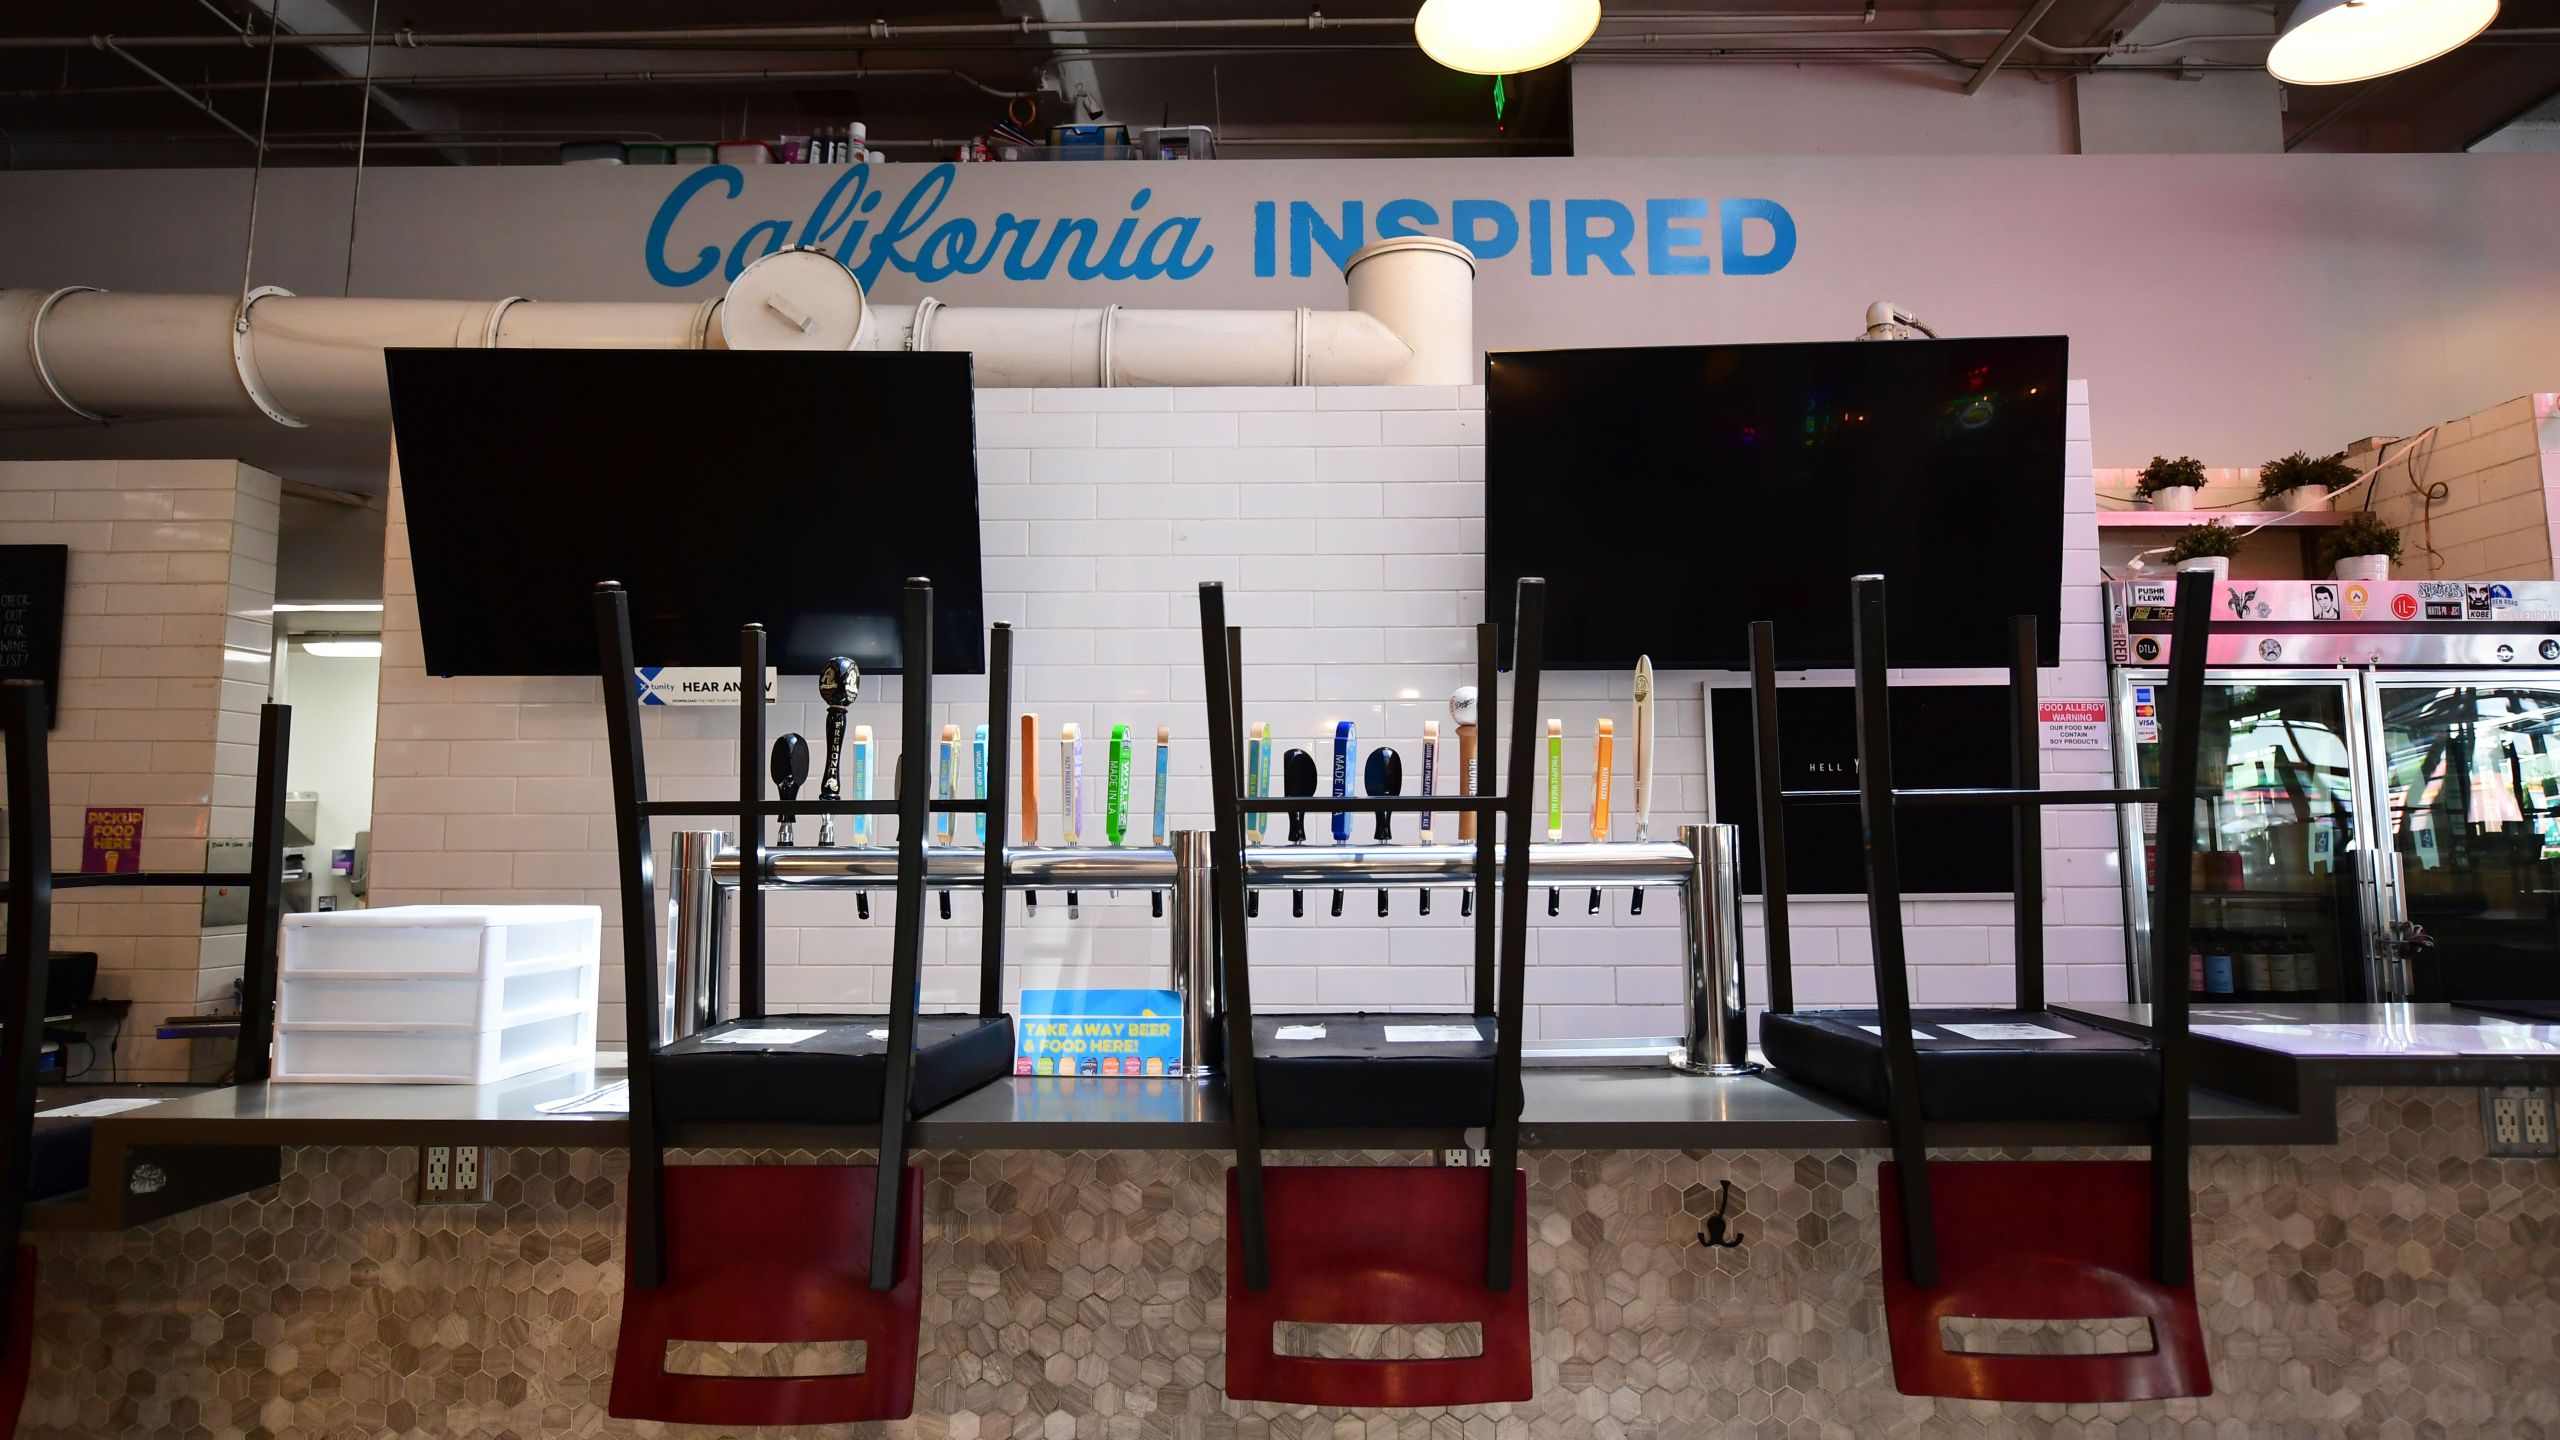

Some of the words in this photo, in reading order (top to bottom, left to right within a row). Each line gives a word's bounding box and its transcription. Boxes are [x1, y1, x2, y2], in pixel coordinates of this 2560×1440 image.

[645, 163, 1214, 297] California
[0, 641, 28, 652] WINE
[2113, 640, 2127, 662] RED
[2138, 645, 2157, 654] DTLA
[651, 683, 675, 691] tunity
[682, 682, 719, 692] HEAR
[723, 682, 741, 692] AN
[765, 682, 772, 692] V
[2040, 703, 2063, 711] FOOD
[2065, 703, 2104, 711] ALLERGY
[2052, 713, 2092, 722] WARNING
[829, 721, 842, 775] FREMONT
[1334, 754, 1344, 784] MADE
[1809, 763, 1843, 772] HELL
[1109, 760, 1118, 787] MADE
[1122, 762, 1130, 810] WOLF
[1109, 790, 1117, 800] IN
[1334, 788, 1343, 797] IN
[1108, 803, 1116, 815] LA
[93, 825, 135, 837] FOOD
[93, 838, 132, 849] HERE
[1025, 1023, 1068, 1037] TAKE
[1071, 1023, 1124, 1037] AWAY
[1128, 1023, 1171, 1037] BEER
[1023, 1040, 1033, 1053] &
[1039, 1040, 1087, 1053] FOOD
[1090, 1040, 1139, 1053] HERE!
